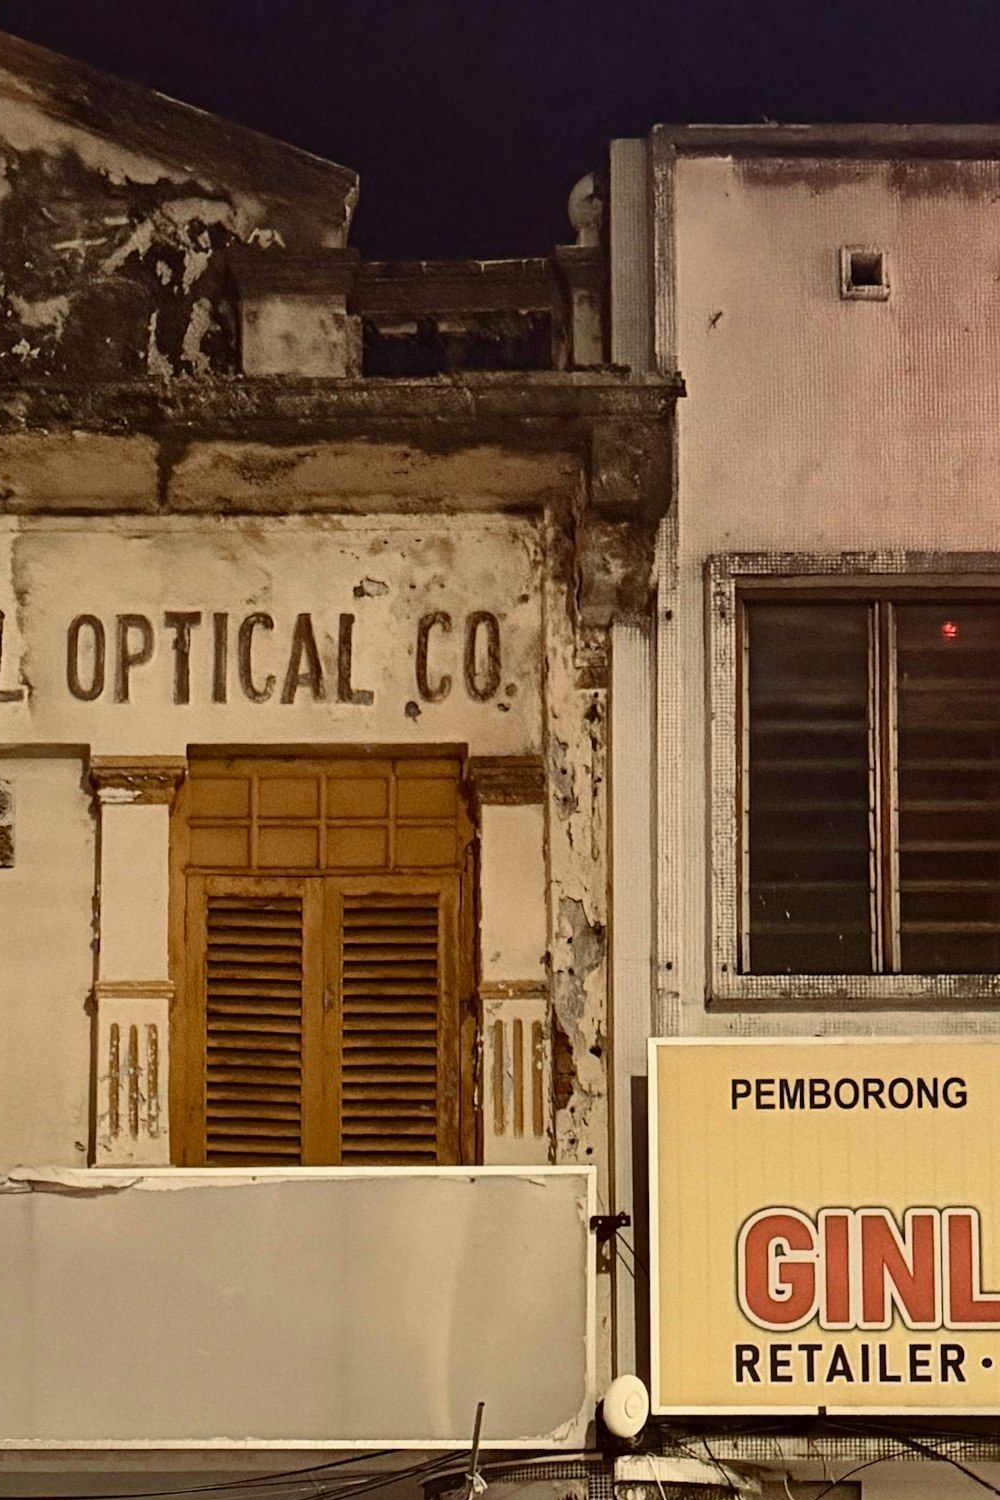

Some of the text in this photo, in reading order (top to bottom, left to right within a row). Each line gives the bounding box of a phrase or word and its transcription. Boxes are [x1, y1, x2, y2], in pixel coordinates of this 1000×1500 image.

[66, 611, 374, 705] OPTICAL
[730, 1076, 968, 1110] PEMBORONG
[735, 1343, 966, 1383] RETAILER
